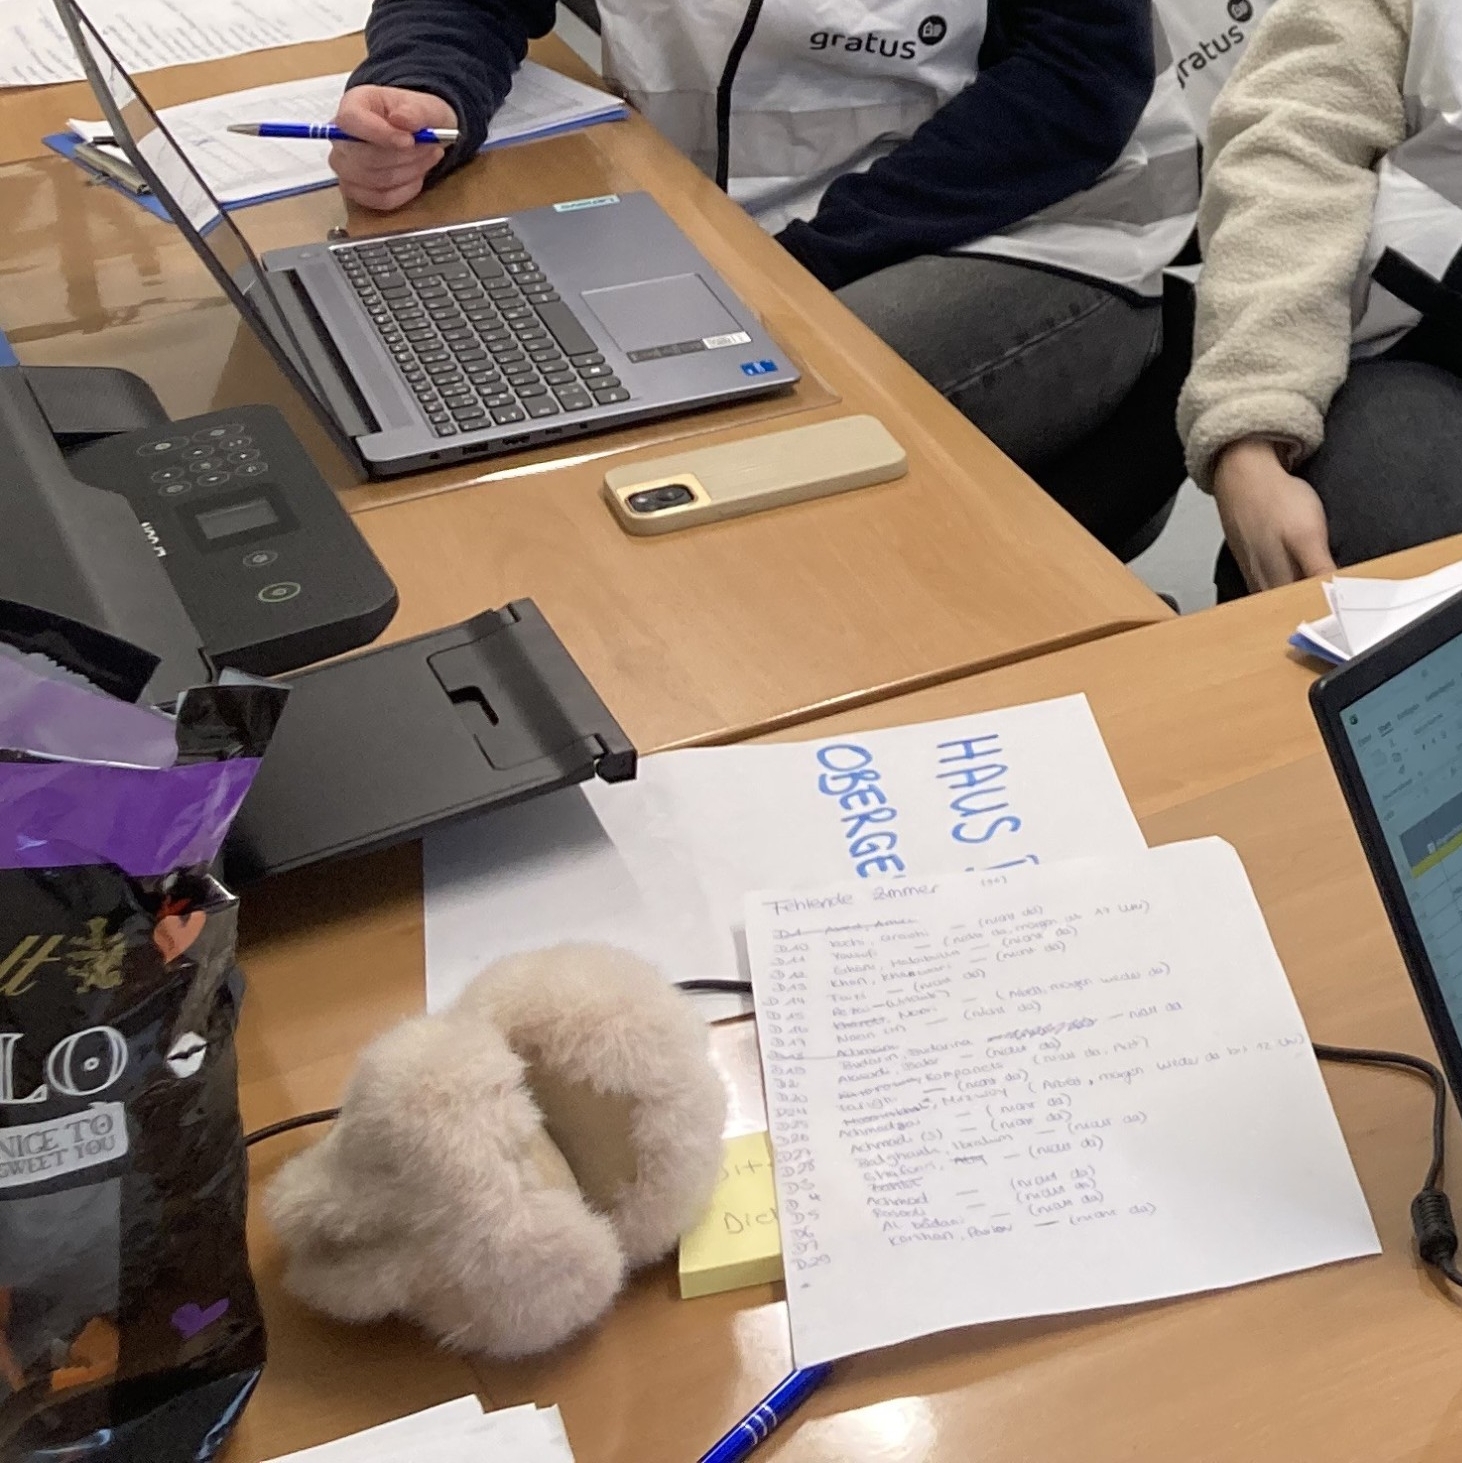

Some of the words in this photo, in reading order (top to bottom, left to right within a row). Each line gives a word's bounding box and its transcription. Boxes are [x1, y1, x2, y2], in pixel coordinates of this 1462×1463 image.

[808, 27, 917, 61] gratus
[936, 733, 1022, 844] HAUS
[816, 743, 906, 880] OBERGE
[0, 1128, 59, 1158] NICE
[65, 1113, 114, 1143] TO
[73, 1135, 116, 1159] YOU
